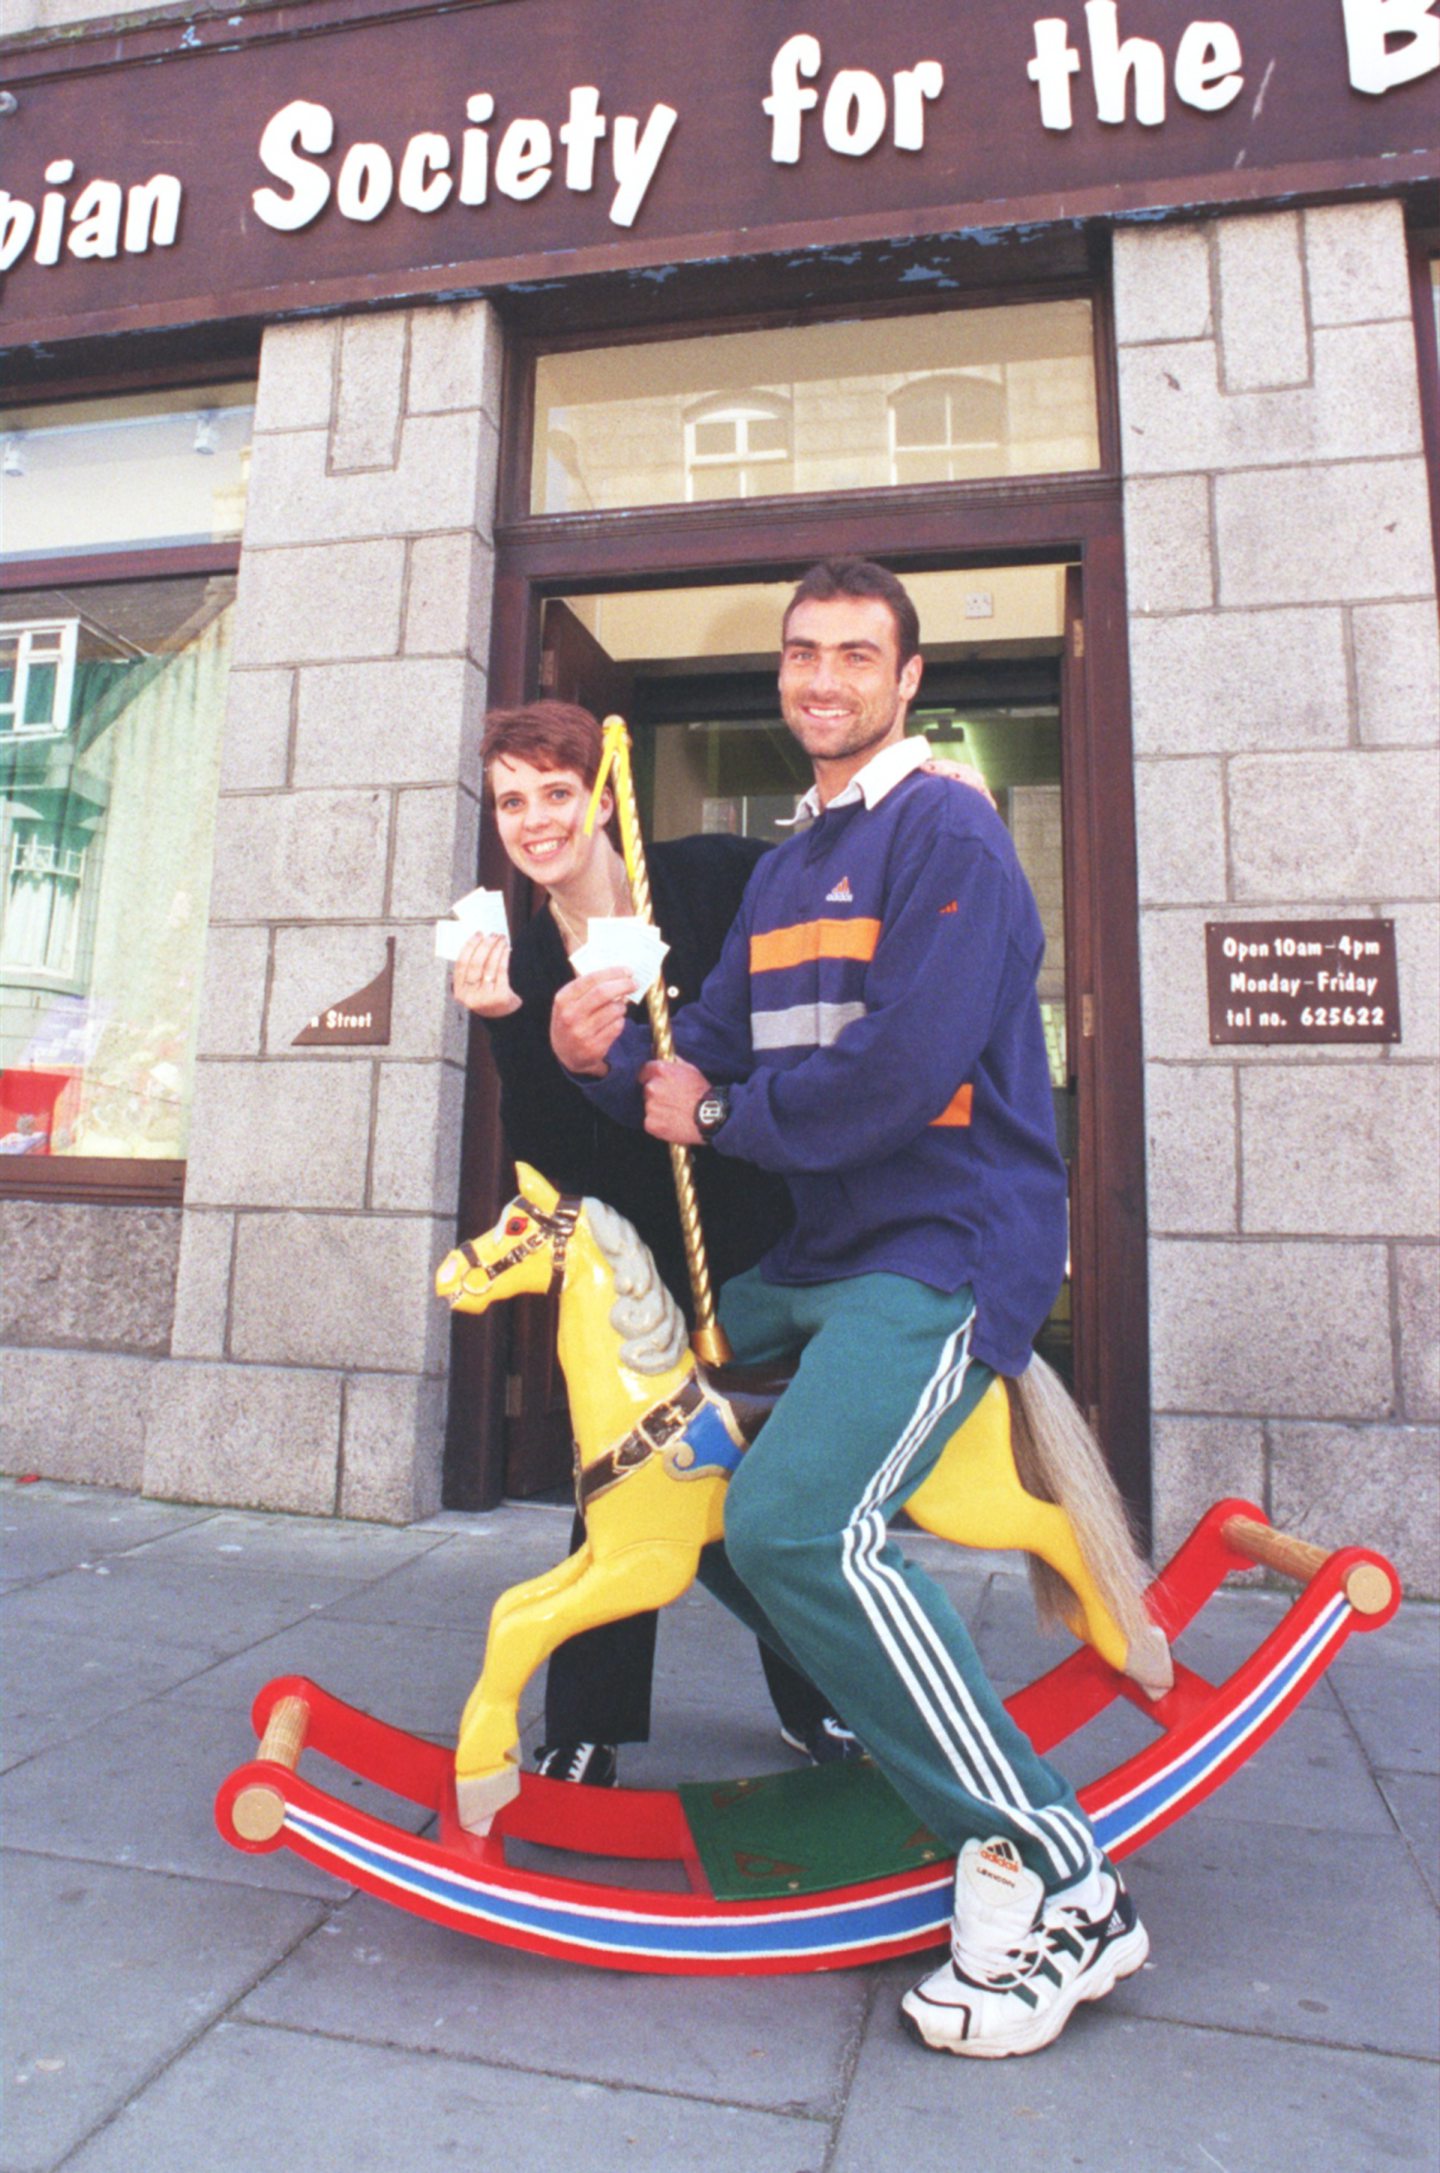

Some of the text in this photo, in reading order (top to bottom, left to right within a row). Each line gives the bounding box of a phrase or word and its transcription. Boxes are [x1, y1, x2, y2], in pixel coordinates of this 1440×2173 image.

[252, 86, 678, 230] Society
[762, 34, 944, 163] for
[1027, 0, 1245, 130] the
[1222, 936, 1270, 962] Open
[325, 1009, 373, 1029] Street
[1226, 1006, 1385, 1027] tel no. 625622
[979, 1848, 1020, 1873] adidas
